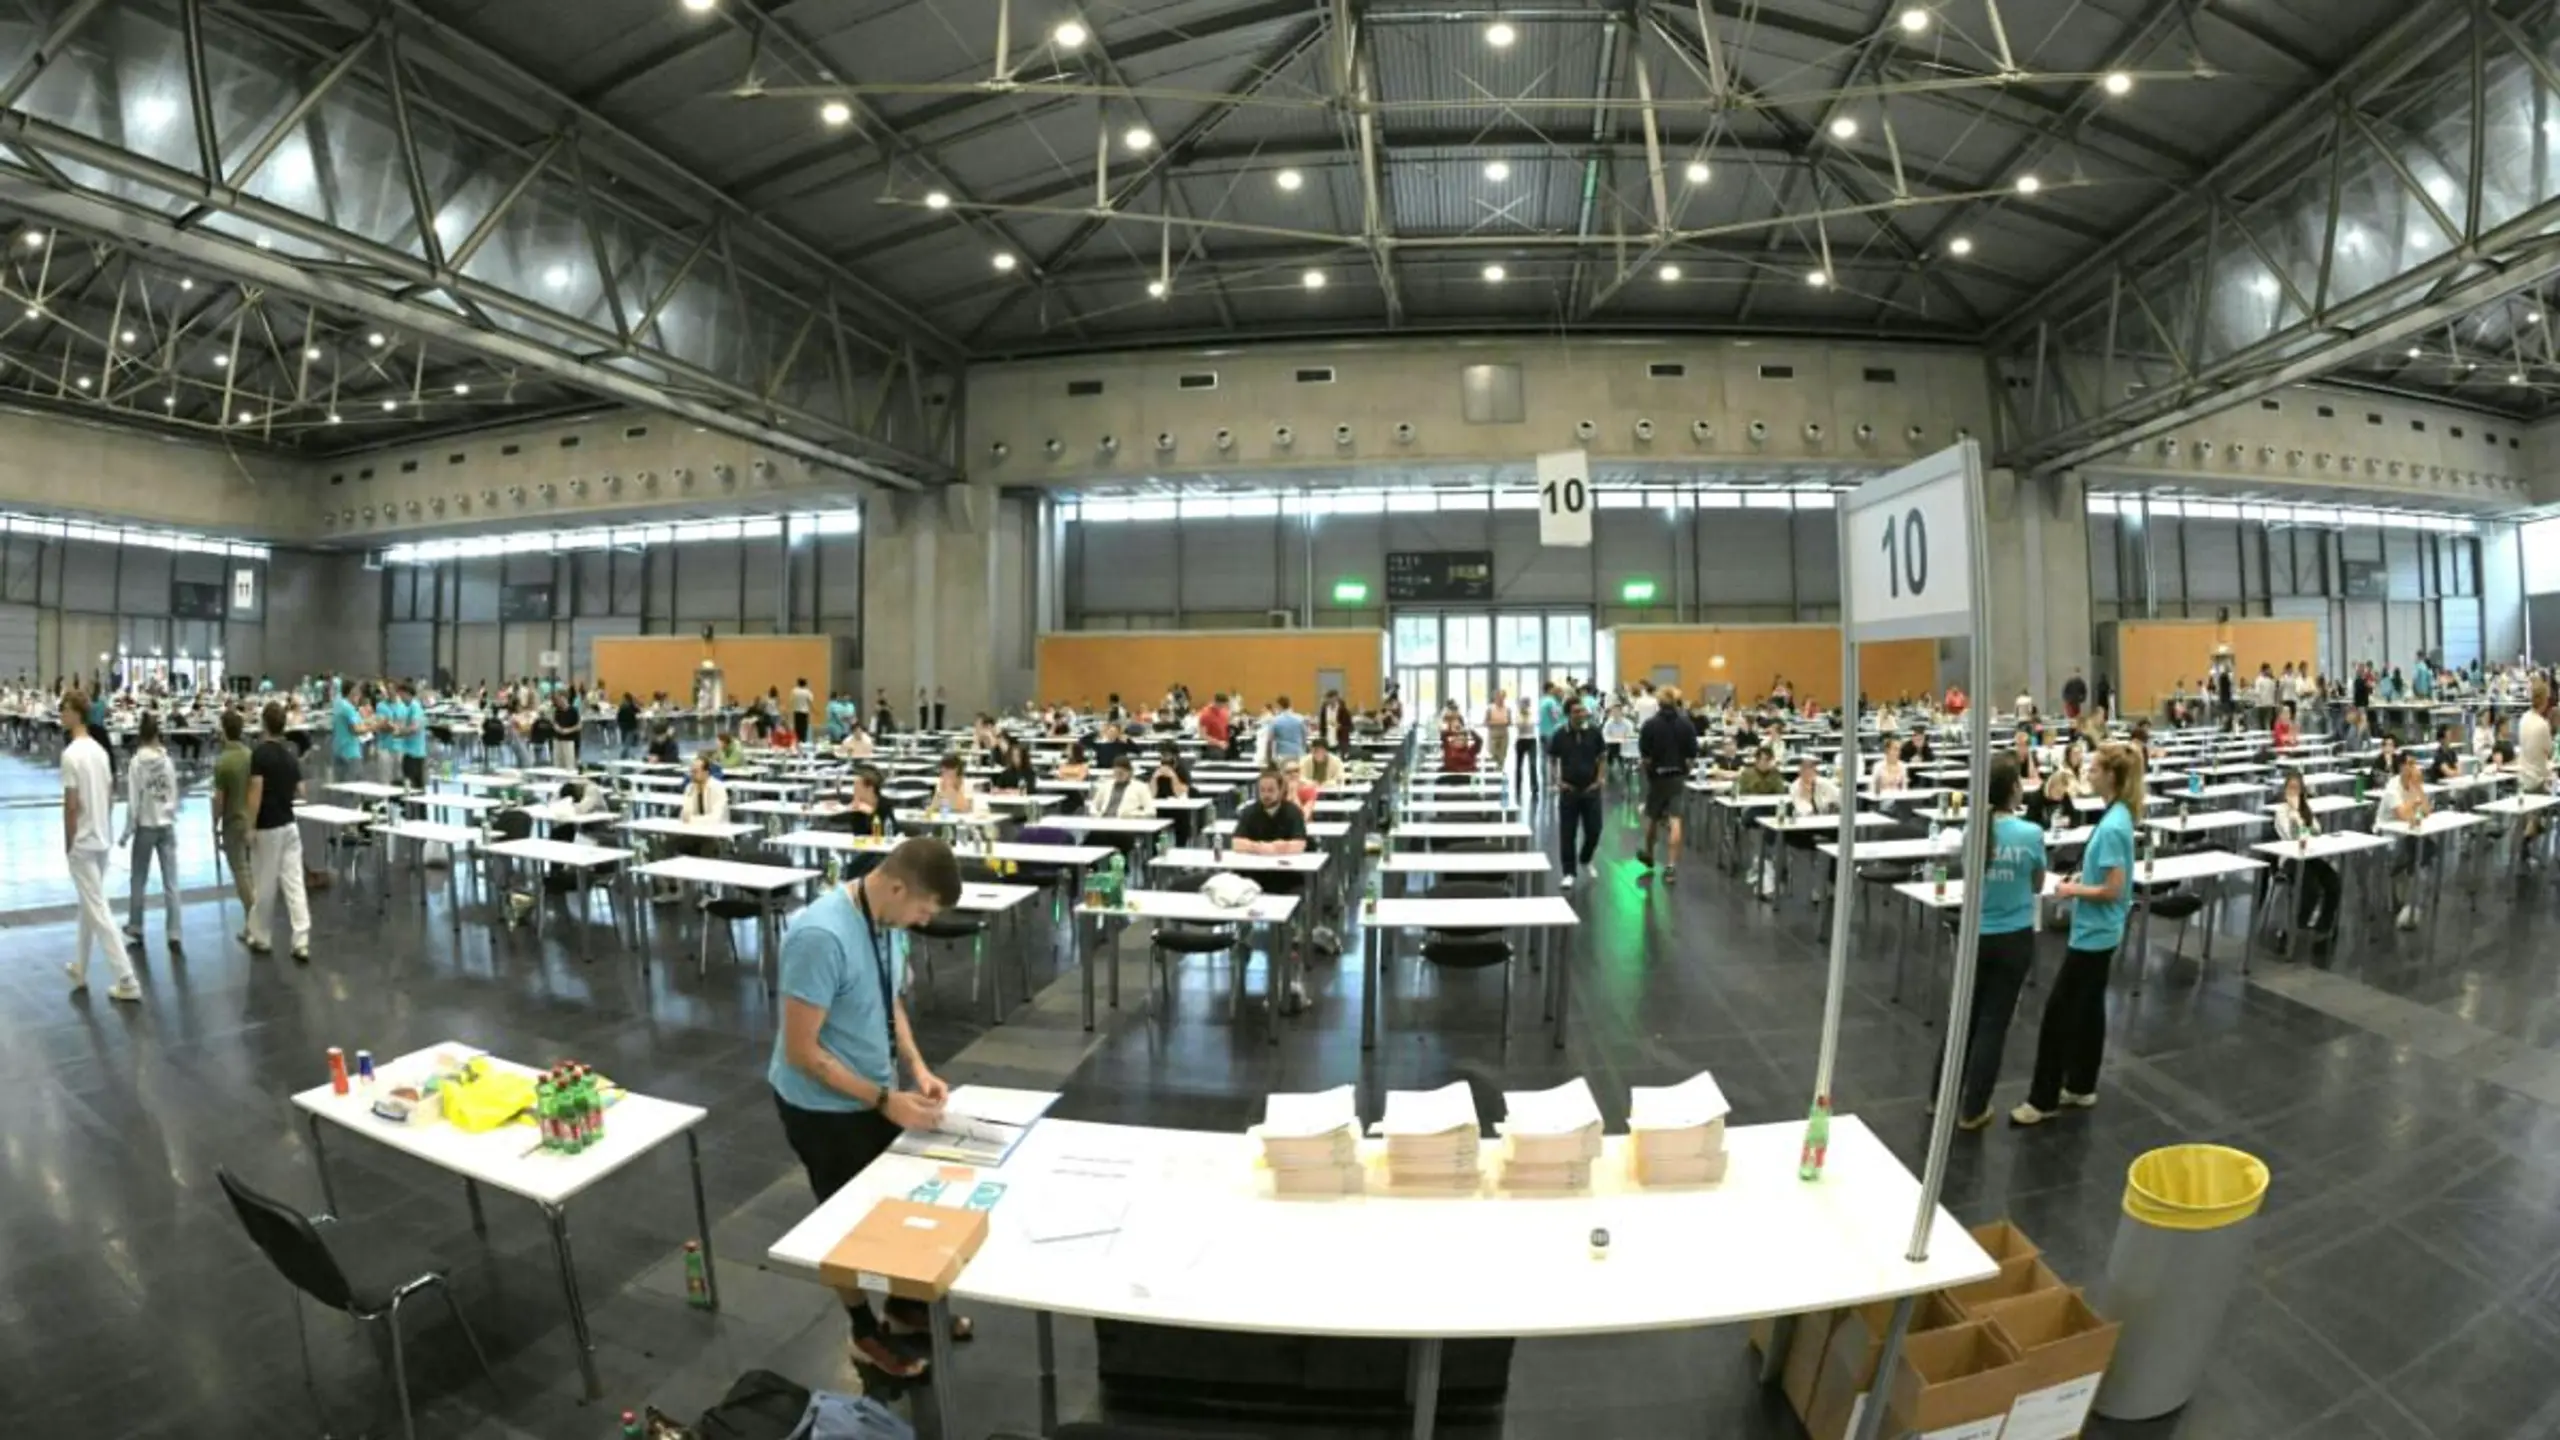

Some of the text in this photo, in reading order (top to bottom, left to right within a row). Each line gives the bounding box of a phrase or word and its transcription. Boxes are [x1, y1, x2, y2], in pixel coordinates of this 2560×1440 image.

[1542, 478, 1585, 514] 10
[1882, 507, 1927, 599] 10
[238, 582, 249, 597] 11
